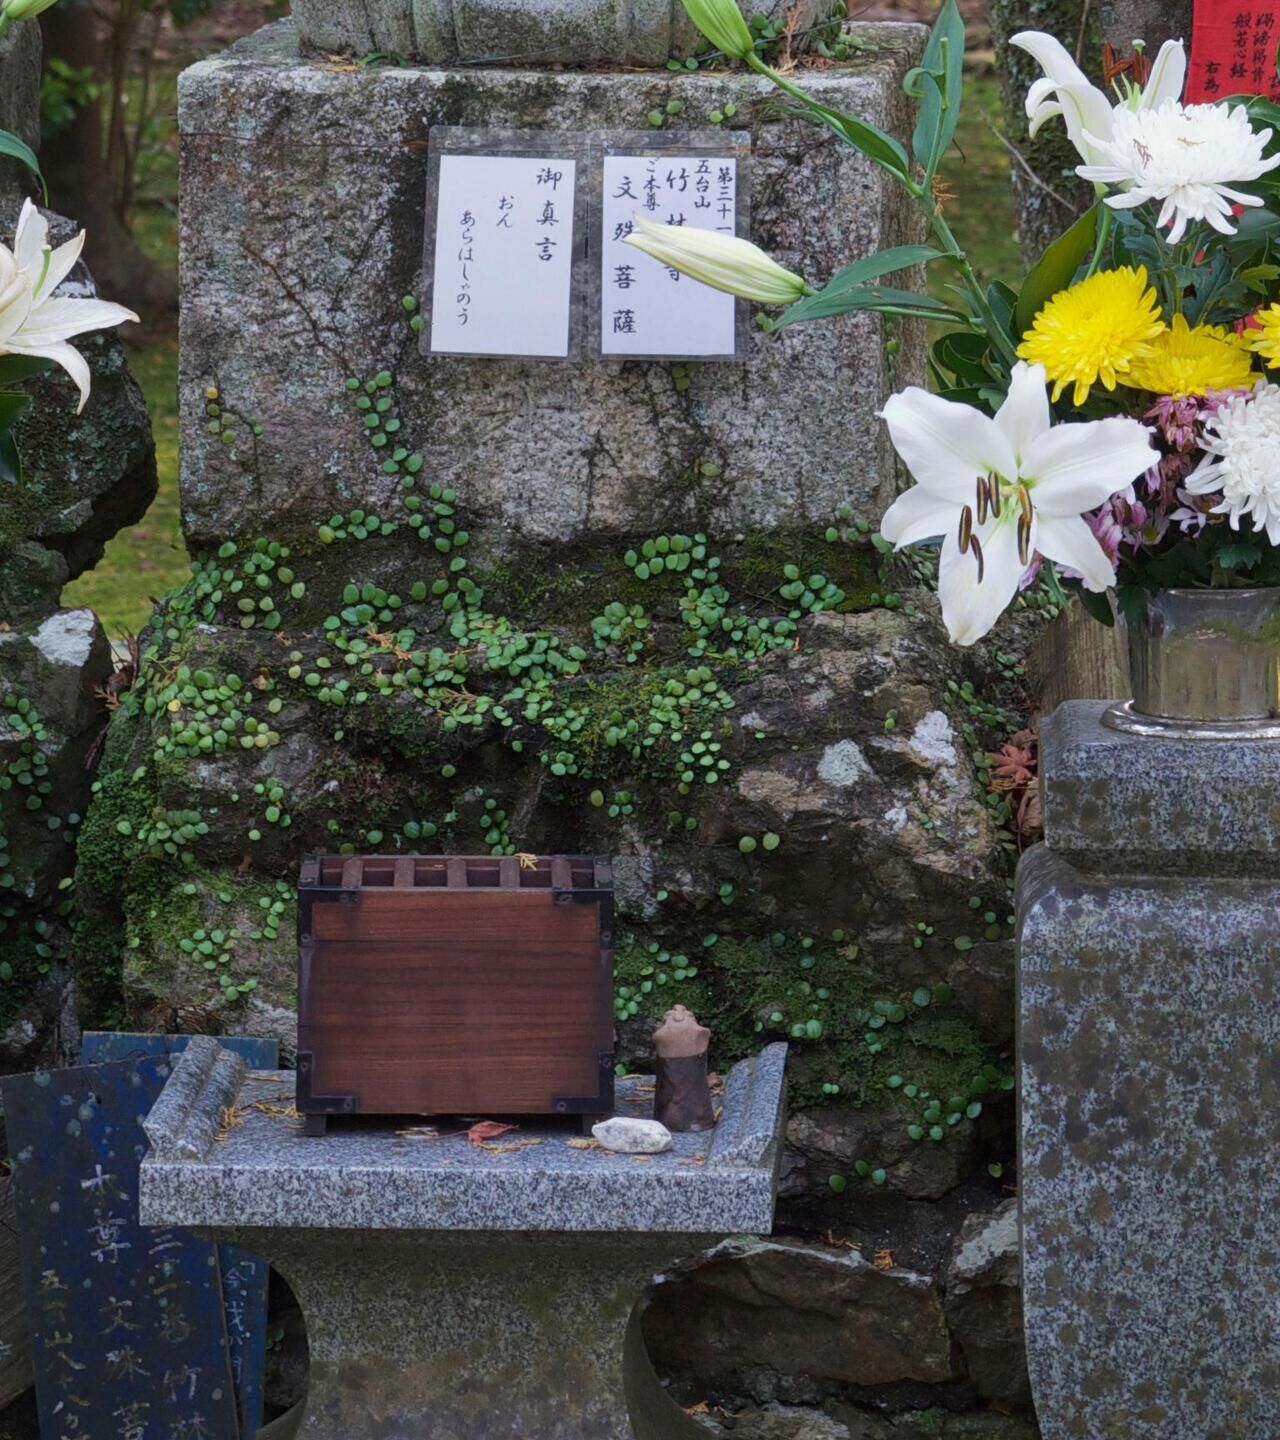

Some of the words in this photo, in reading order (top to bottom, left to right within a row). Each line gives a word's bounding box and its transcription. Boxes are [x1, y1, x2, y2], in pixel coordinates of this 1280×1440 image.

[495, 195, 516, 229] おん
[535, 167, 563, 261] 御真言
[642, 158, 661, 211] ご本尊
[694, 160, 712, 209] 五台山
[716, 166, 734, 231] 第三十一
[455, 211, 476, 326] あらはしゃのう
[612, 176, 638, 334] 文殊菩薩
